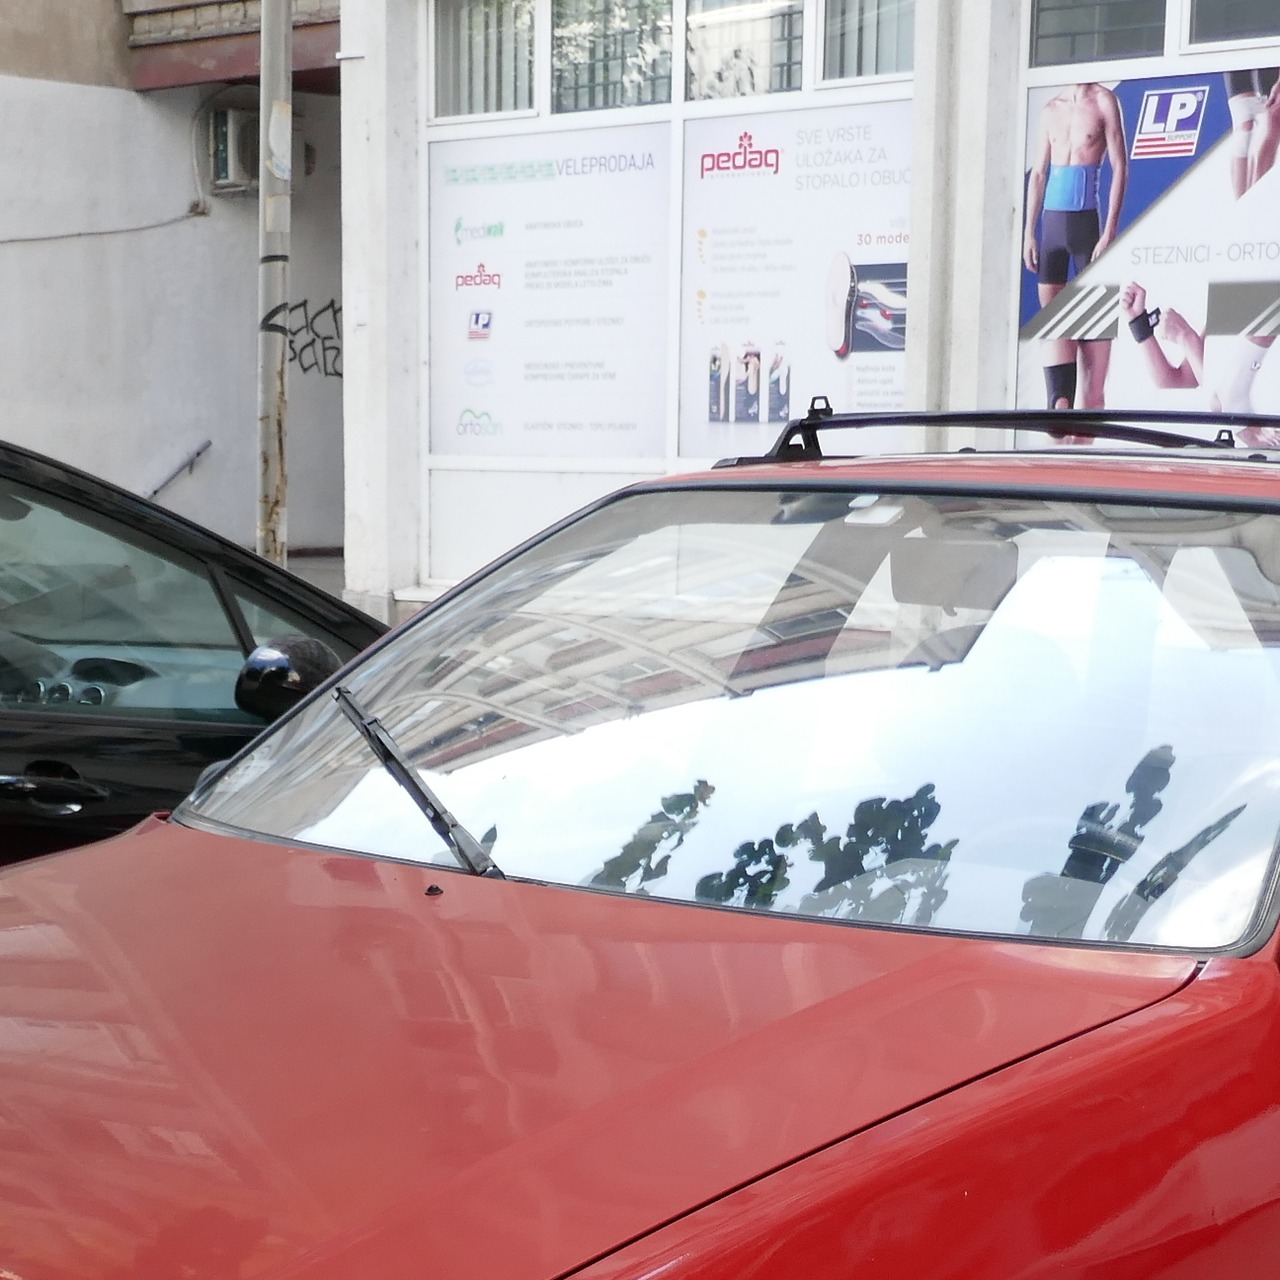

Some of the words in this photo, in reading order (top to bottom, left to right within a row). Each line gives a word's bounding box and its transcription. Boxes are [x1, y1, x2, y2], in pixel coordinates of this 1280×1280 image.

[1141, 92, 1198, 133] LP
[796, 129, 821, 146] SVE
[827, 125, 871, 144] VRSTE
[1167, 133, 1196, 142] SUPPORT
[556, 153, 655, 176] VELEPRODAJA
[701, 142, 779, 179] pedag
[869, 148, 887, 163] ZA
[795, 172, 860, 191] STOPALO
[856, 234, 871, 246] 30
[1131, 245, 1210, 266] STEZNICI
[456, 268, 501, 291] pedag
